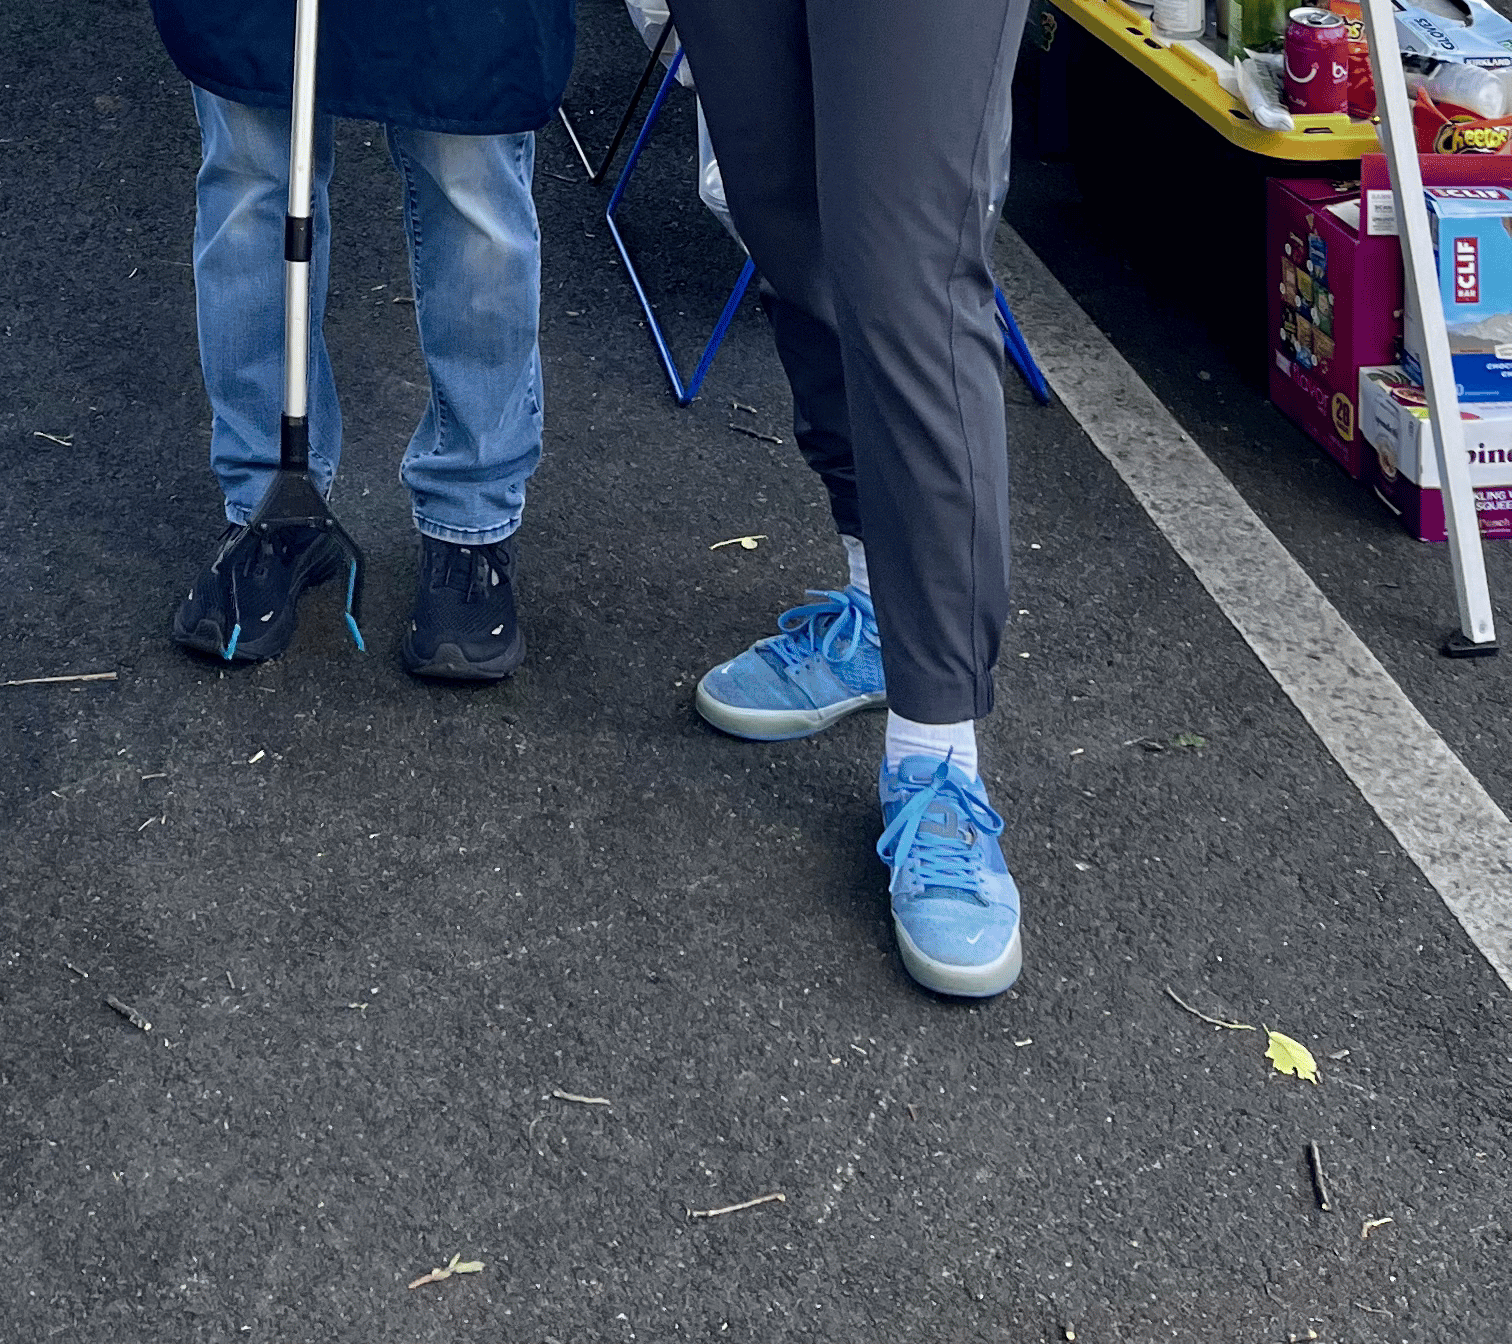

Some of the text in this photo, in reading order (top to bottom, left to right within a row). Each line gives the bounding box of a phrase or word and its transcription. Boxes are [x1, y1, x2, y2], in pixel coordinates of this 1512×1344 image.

[1414, 17, 1455, 51] GLOVES
[1446, 189, 1500, 199] CLIF
[1457, 240, 1476, 289] CLIF
